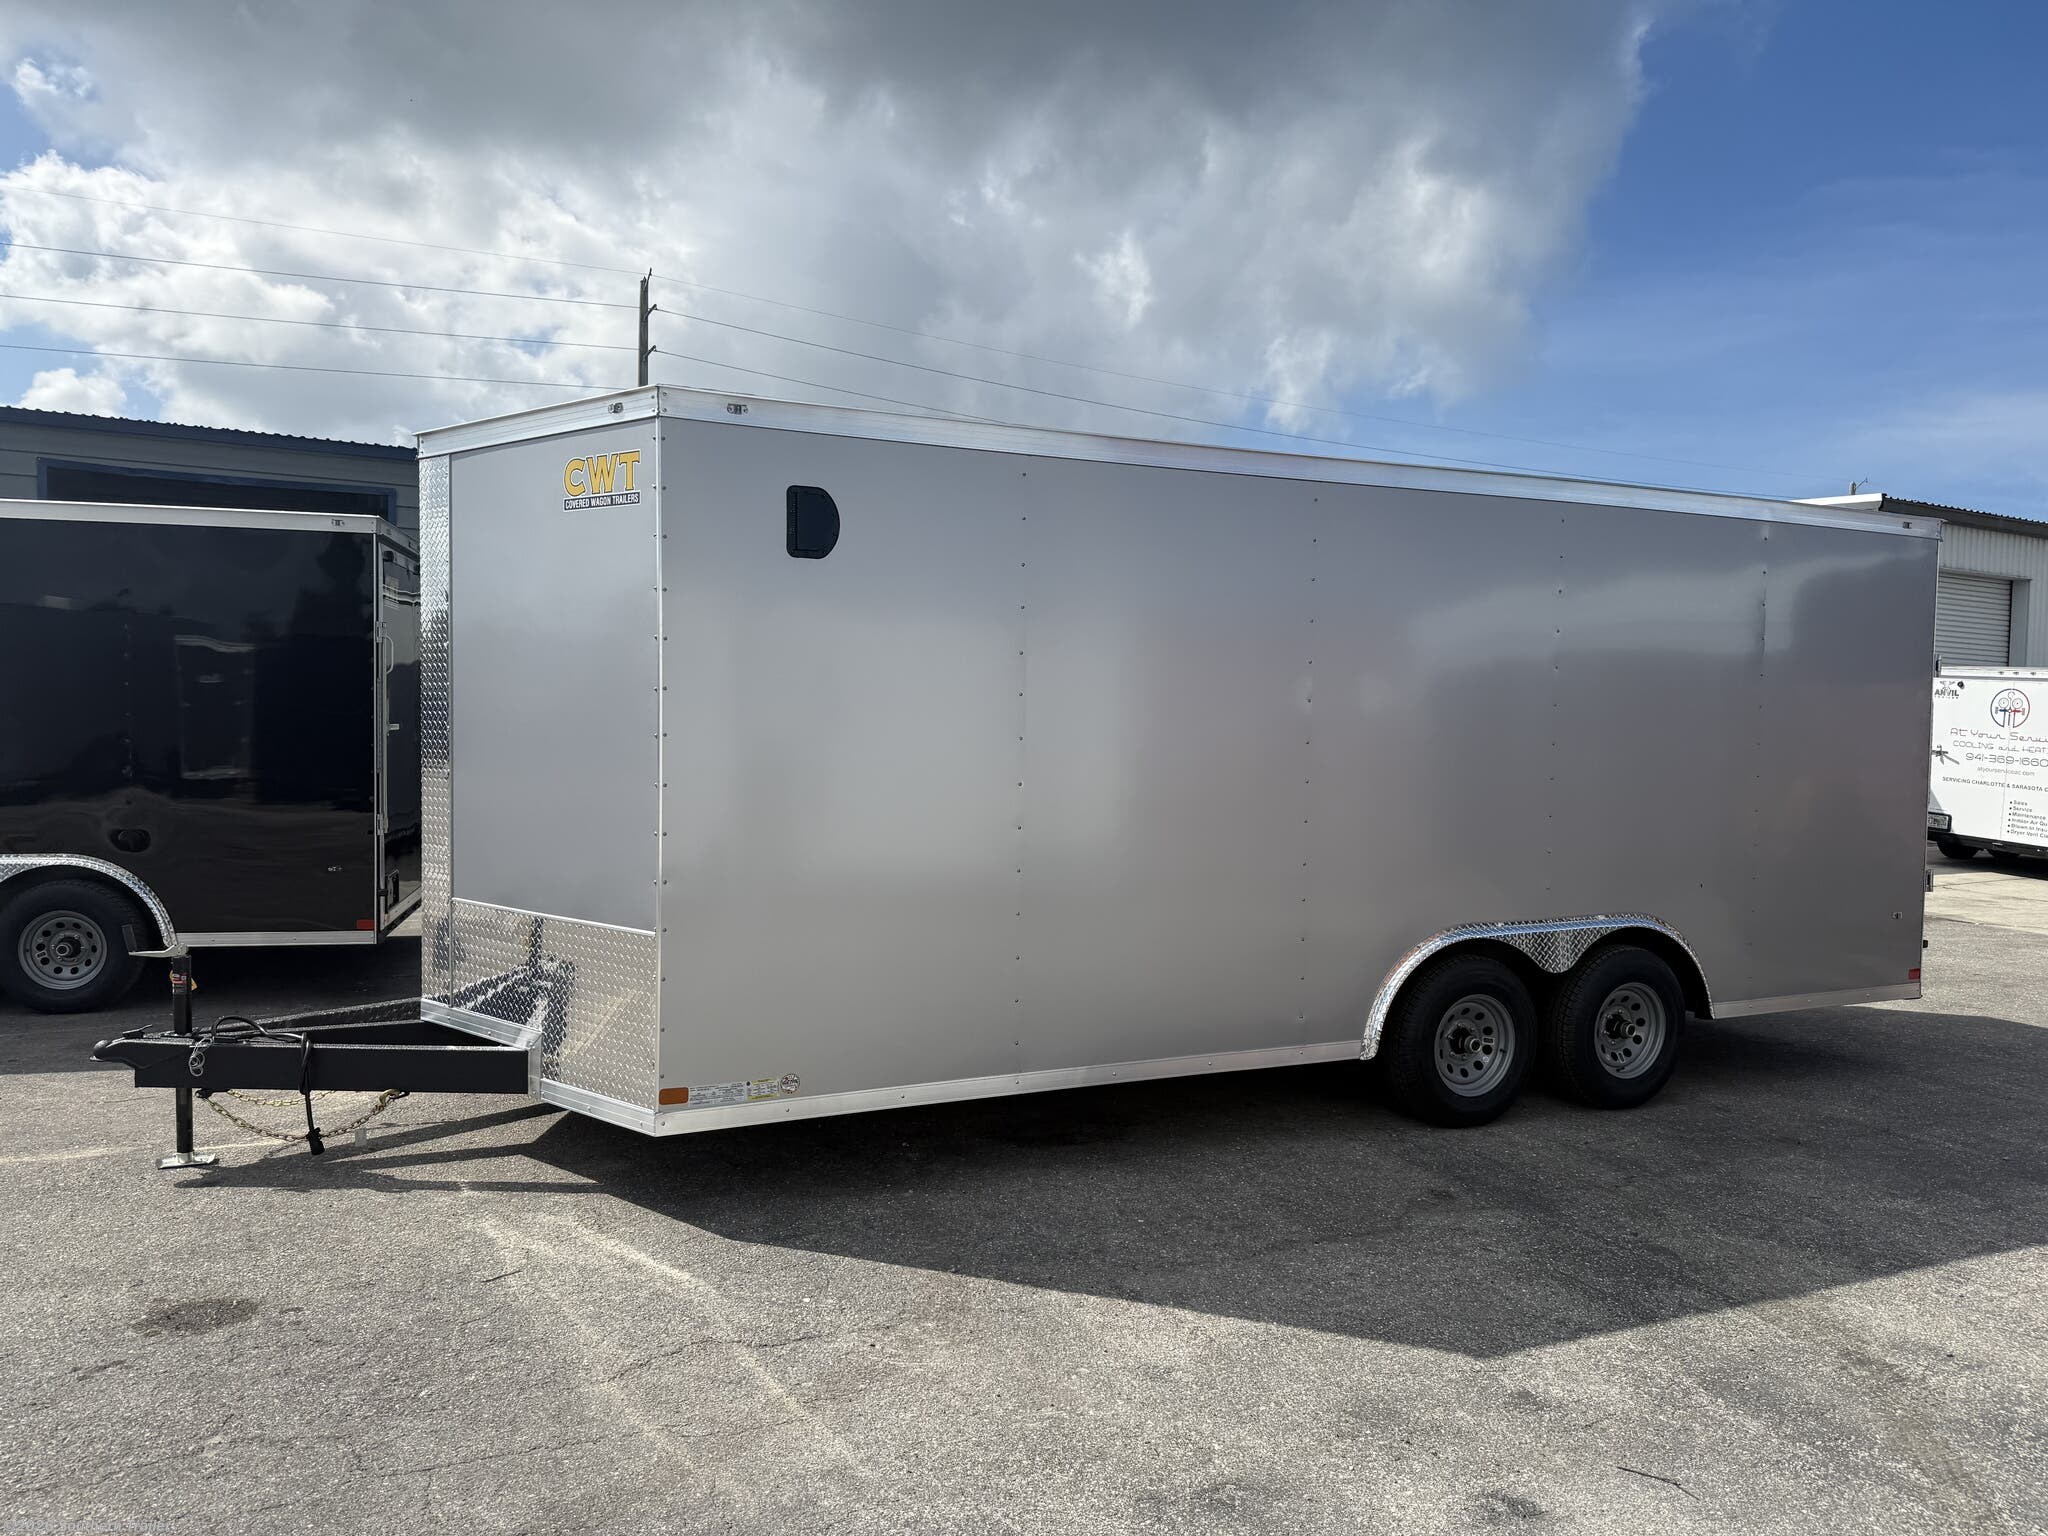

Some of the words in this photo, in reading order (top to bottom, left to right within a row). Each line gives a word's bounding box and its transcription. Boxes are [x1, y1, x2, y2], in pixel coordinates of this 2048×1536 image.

[564, 450, 640, 497] CWT
[565, 499, 589, 509] COVERED
[590, 496, 612, 507] WAGON
[612, 493, 639, 504] TRAILERS
[1934, 689, 1960, 697] ANVIL
[1953, 740, 1994, 750] COOLING
[2022, 746, 2048, 754] HEAT
[1942, 776, 1971, 784] SERVICING
[1971, 779, 2005, 788] CHARLOTTE
[2012, 783, 2043, 792] SARASOTA
